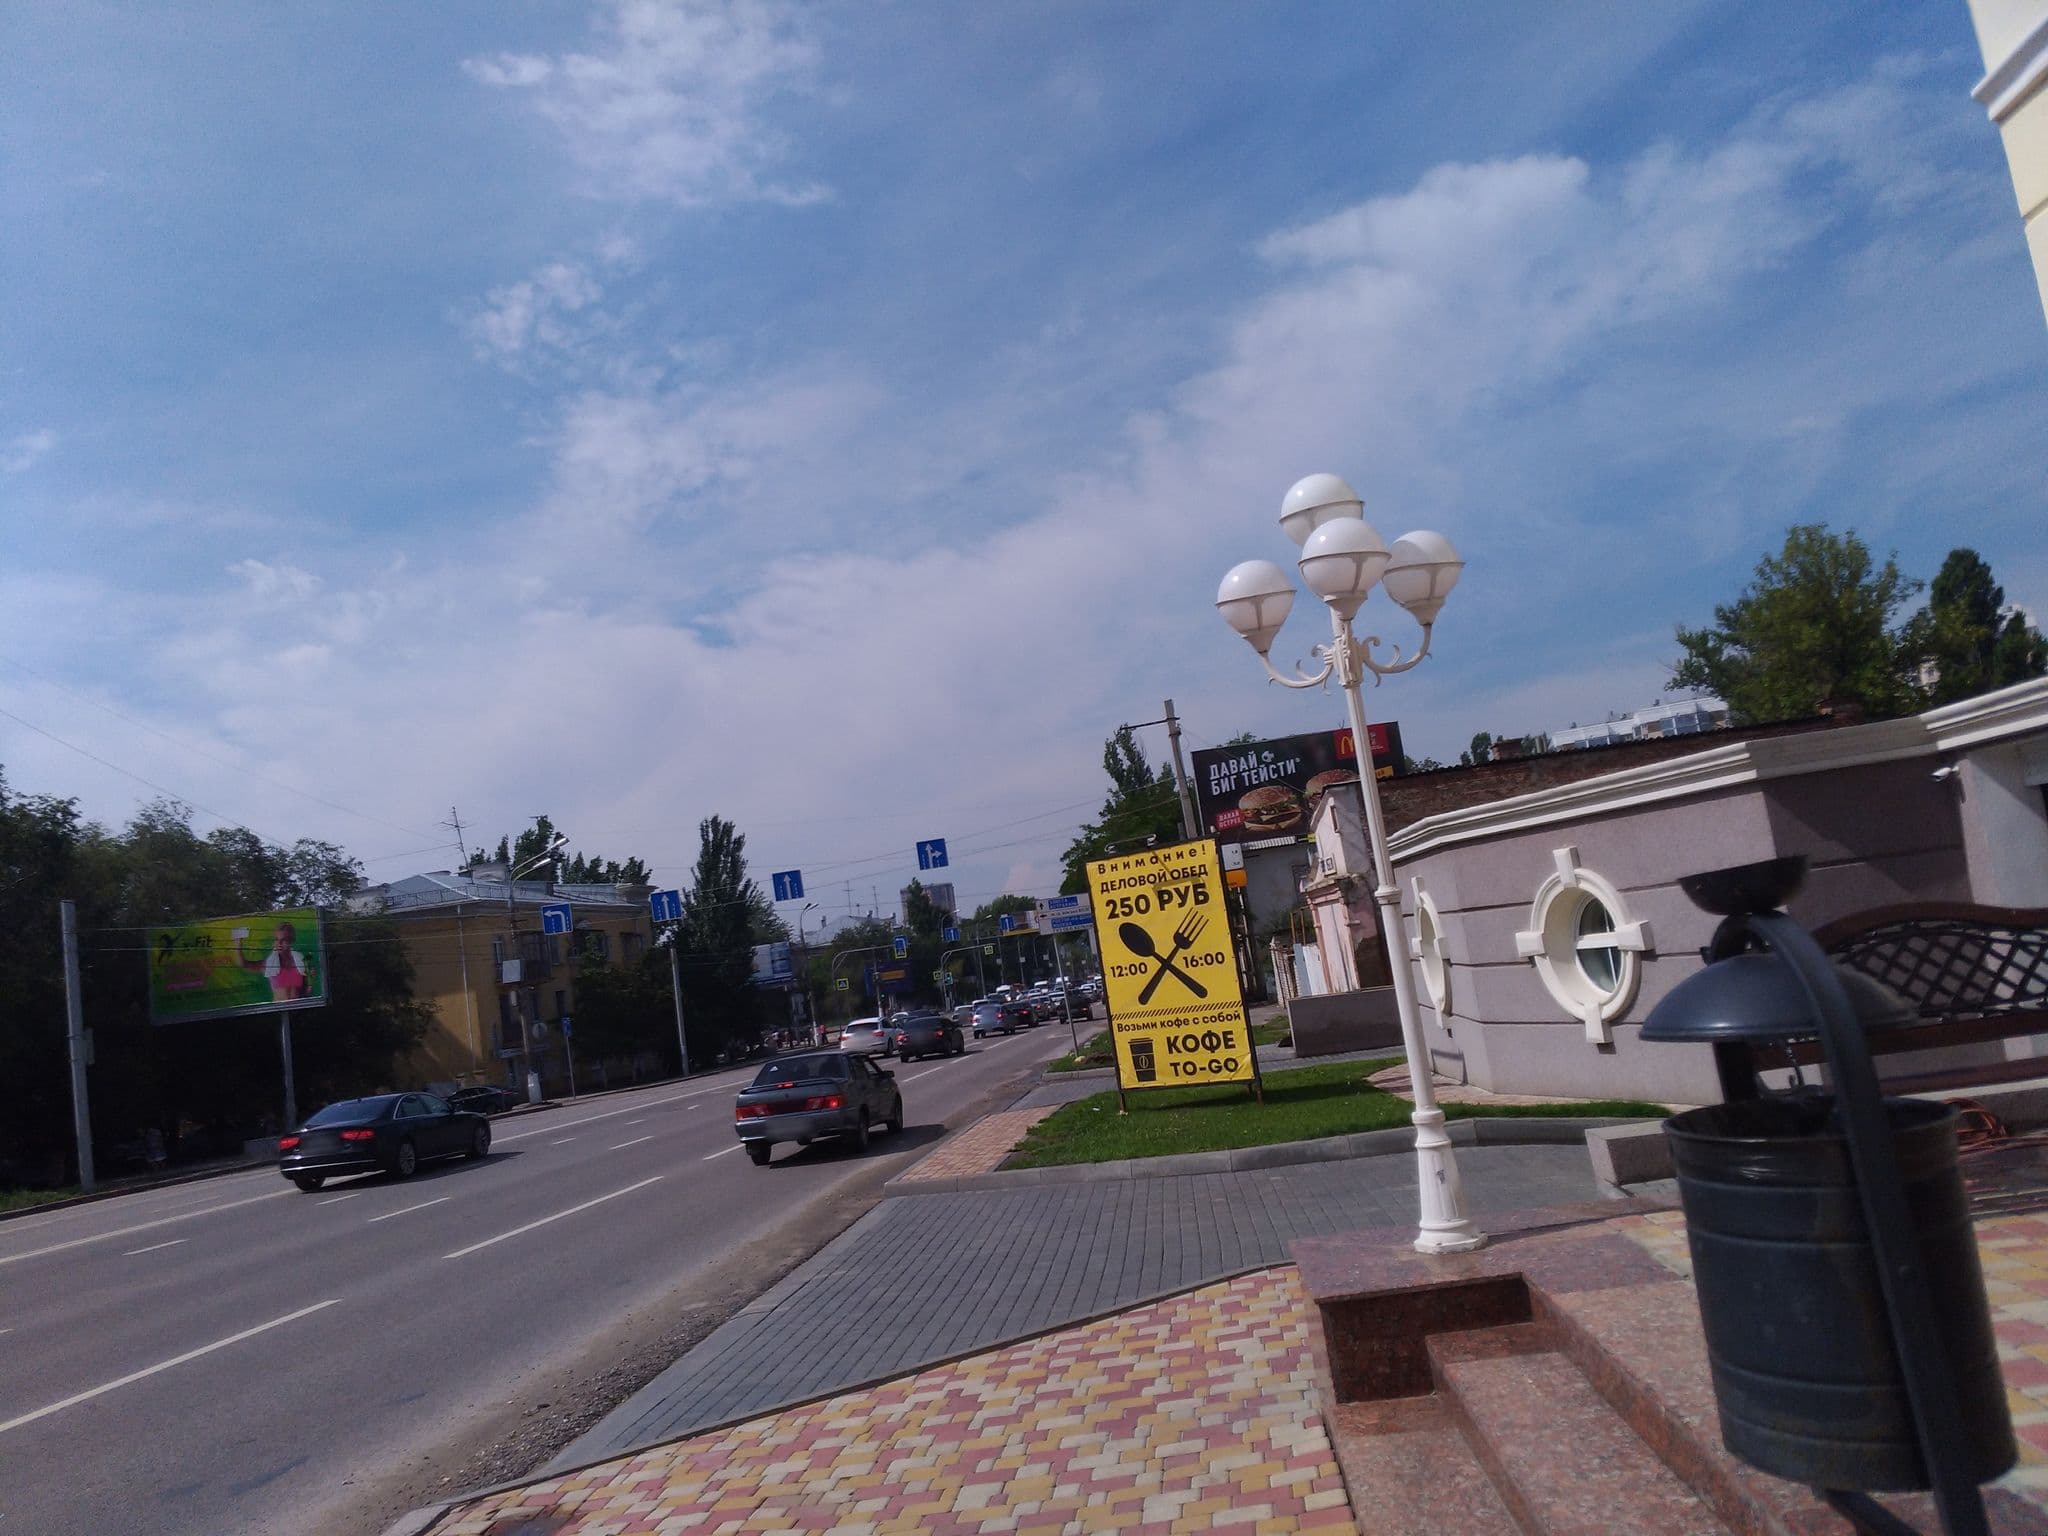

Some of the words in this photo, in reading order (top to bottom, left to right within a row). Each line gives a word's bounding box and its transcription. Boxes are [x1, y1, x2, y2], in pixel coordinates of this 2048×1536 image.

[1209, 750, 1258, 780] ДАВАЙ
[1211, 775, 1237, 796] БИГ
[1097, 844, 1206, 874] Внимание!
[1101, 868, 1167, 894] ДЕЛОВОЙ
[1170, 864, 1209, 881] ОБЕД
[1105, 894, 1151, 920] 250
[1157, 882, 1210, 911] РУБ
[1110, 962, 1148, 978] 12:00
[1183, 952, 1225, 968] 16:00
[1117, 1022, 1157, 1033] Возьми
[1160, 1017, 1190, 1028] кофе
[1192, 1017, 1200, 1025] с
[1202, 1010, 1241, 1024] собой
[1166, 1029, 1236, 1055] КОФЕ
[1169, 1057, 1239, 1077] TO-GO
